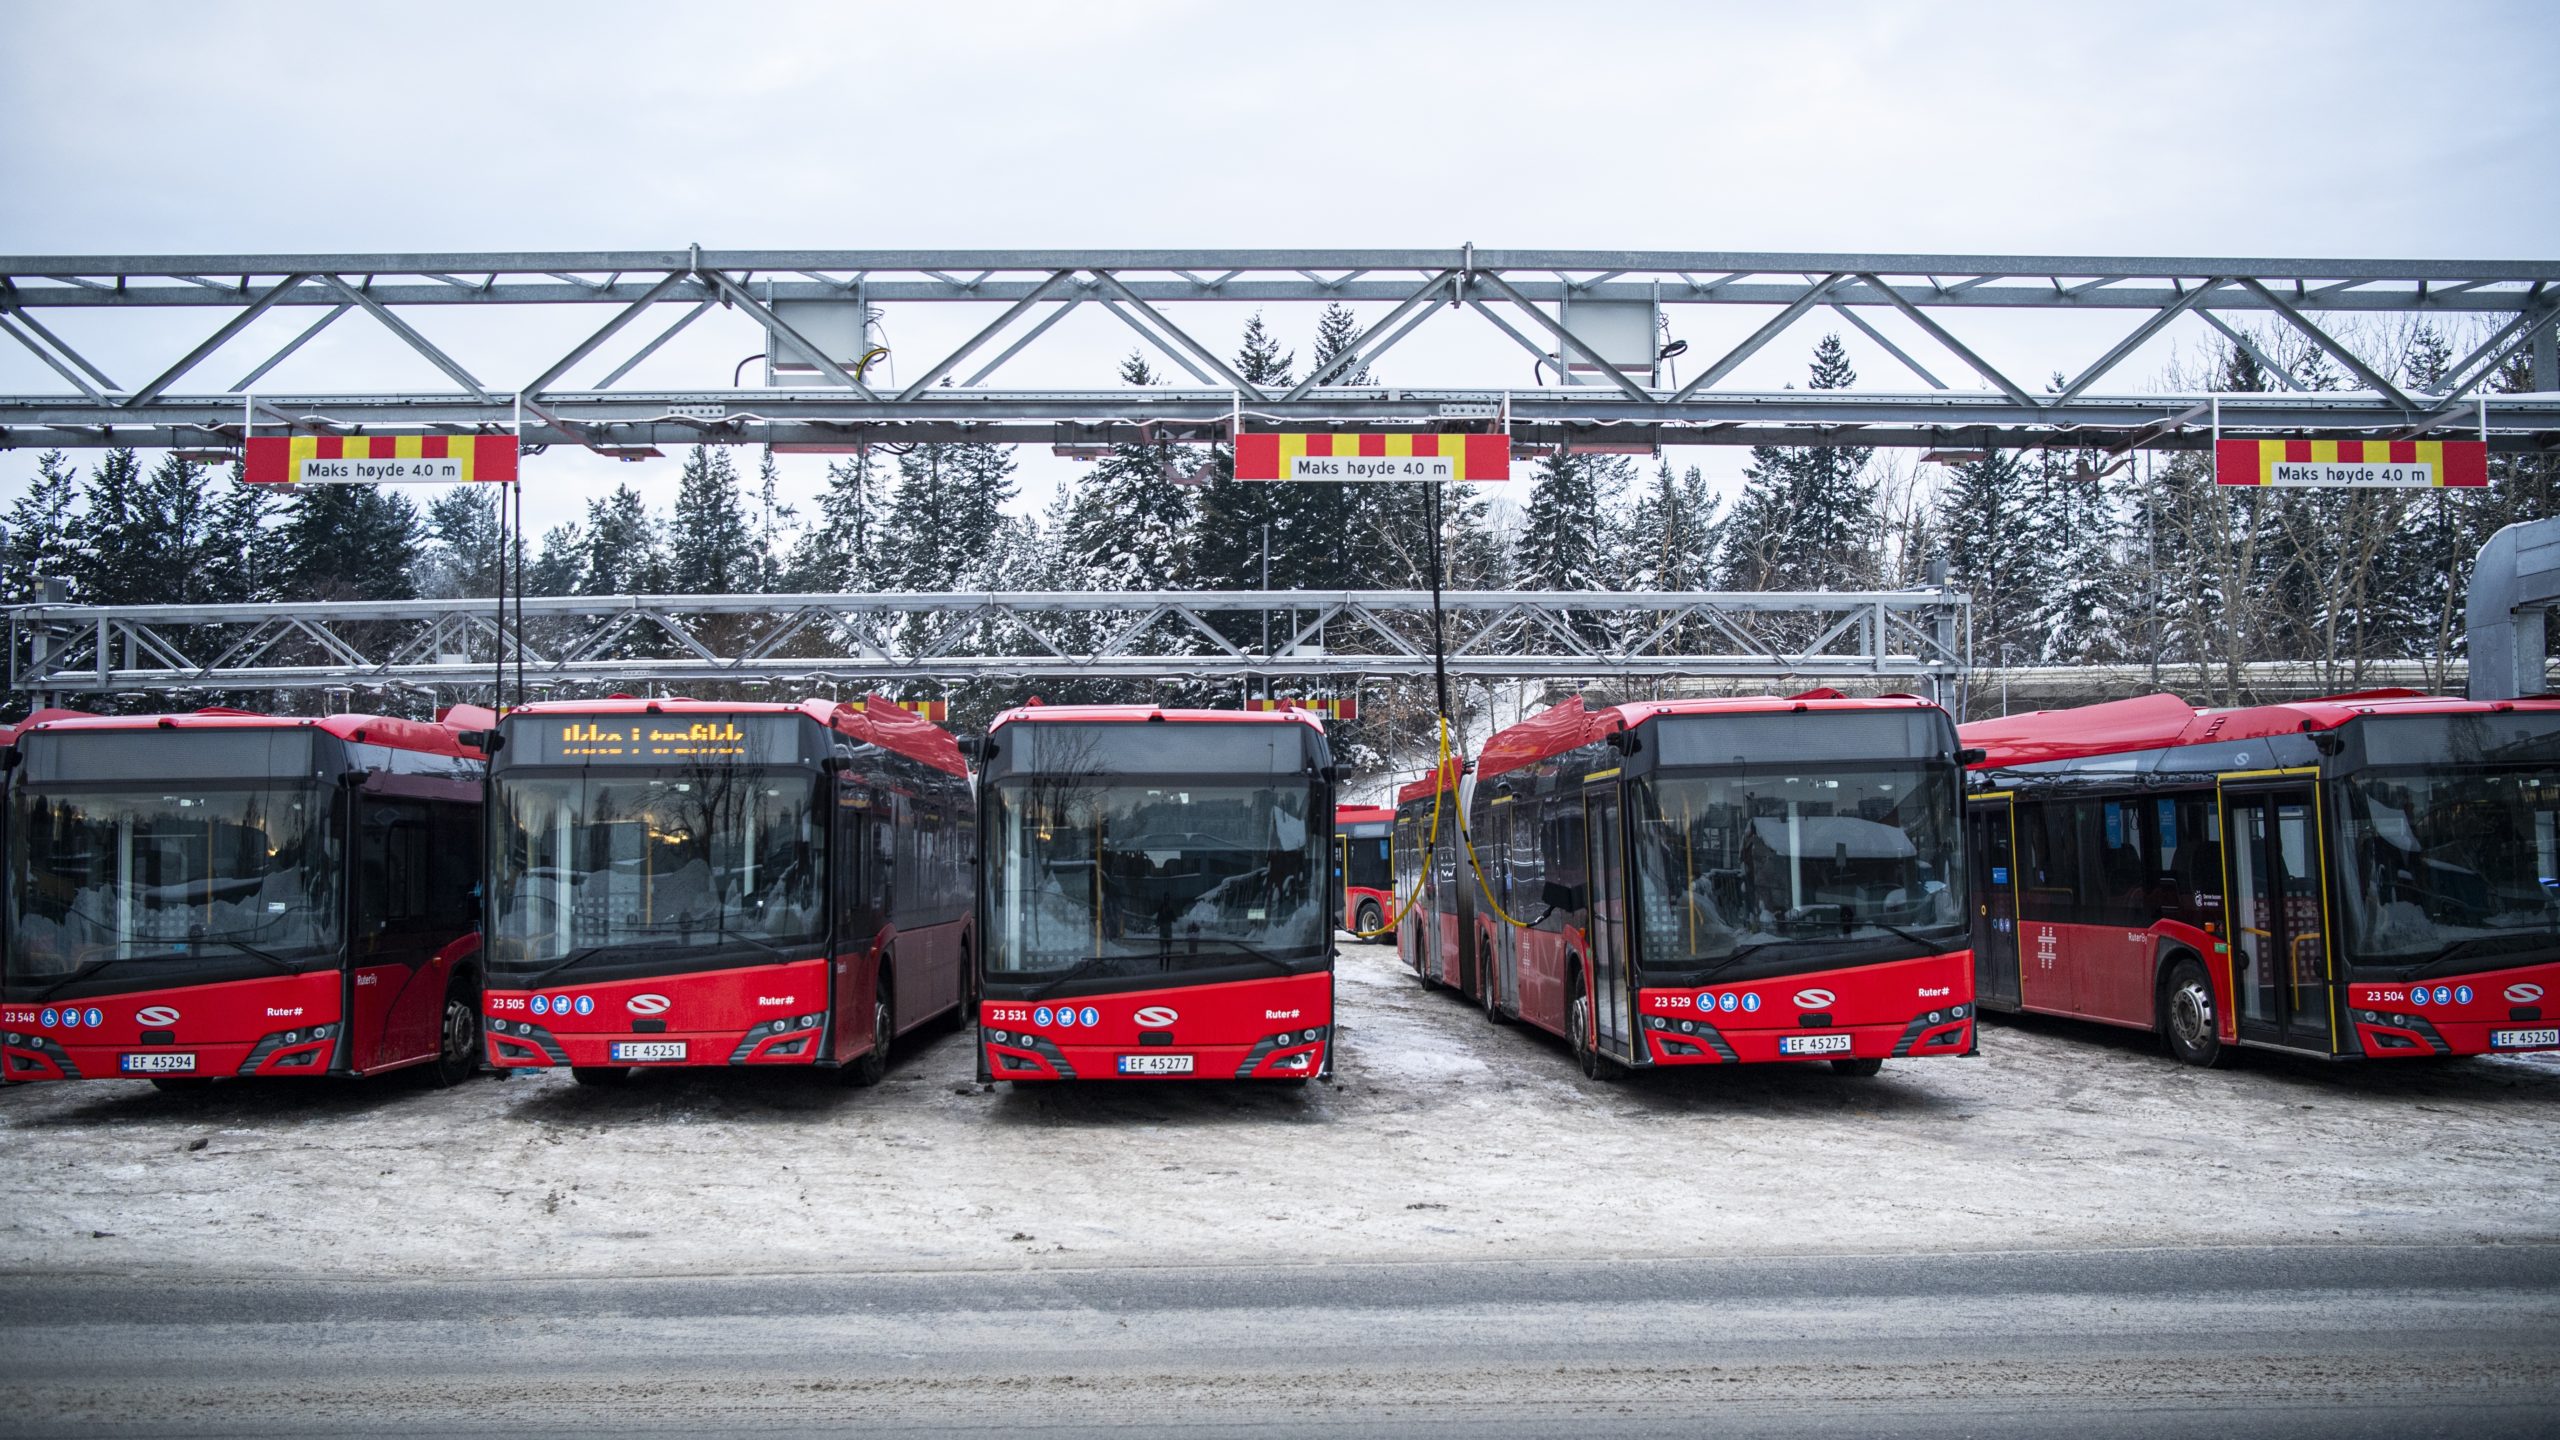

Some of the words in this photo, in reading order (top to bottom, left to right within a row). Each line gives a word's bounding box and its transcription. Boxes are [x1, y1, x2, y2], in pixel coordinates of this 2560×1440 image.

[308, 463, 349, 477] Maks
[357, 463, 405, 480] høyde
[412, 464, 433, 477] 4.0
[442, 465, 455, 476] m
[1298, 461, 1339, 475] Maks
[1348, 461, 1395, 478] høyde
[1403, 462, 1425, 475] 4.0
[1433, 463, 1447, 475] m
[2278, 467, 2319, 481] Maks
[2326, 467, 2374, 484] høyde
[2382, 469, 2403, 482] 4.0
[2412, 470, 2425, 481] m
[631, 727, 640, 754] i
[1918, 987, 1949, 997] Ruter#
[2367, 991, 2380, 1001] 23
[2384, 991, 2404, 1001] 504
[493, 998, 504, 1009] 23
[506, 998, 525, 1009] 505
[759, 996, 794, 1005] Ruter#
[1655, 997, 1668, 1007] 23
[1671, 997, 1690, 1007] 529
[267, 1007, 303, 1016] Ruter#
[993, 1009, 1005, 1020] 23
[1008, 1010, 1027, 1021] 531
[1266, 1009, 1300, 1019] Ruter#
[5, 1012, 15, 1022] 23
[18, 1012, 35, 1023] 548
[2501, 1033, 2514, 1044] EF
[2520, 1031, 2556, 1043] 45250
[1791, 1039, 1804, 1050] EF
[1810, 1037, 1846, 1050] 45275
[624, 1045, 638, 1056] EF
[644, 1045, 681, 1056] 45251
[133, 1056, 147, 1068] EF
[152, 1056, 191, 1068] 45294
[1131, 1058, 1144, 1069] EF
[1150, 1058, 1188, 1069] 45277
